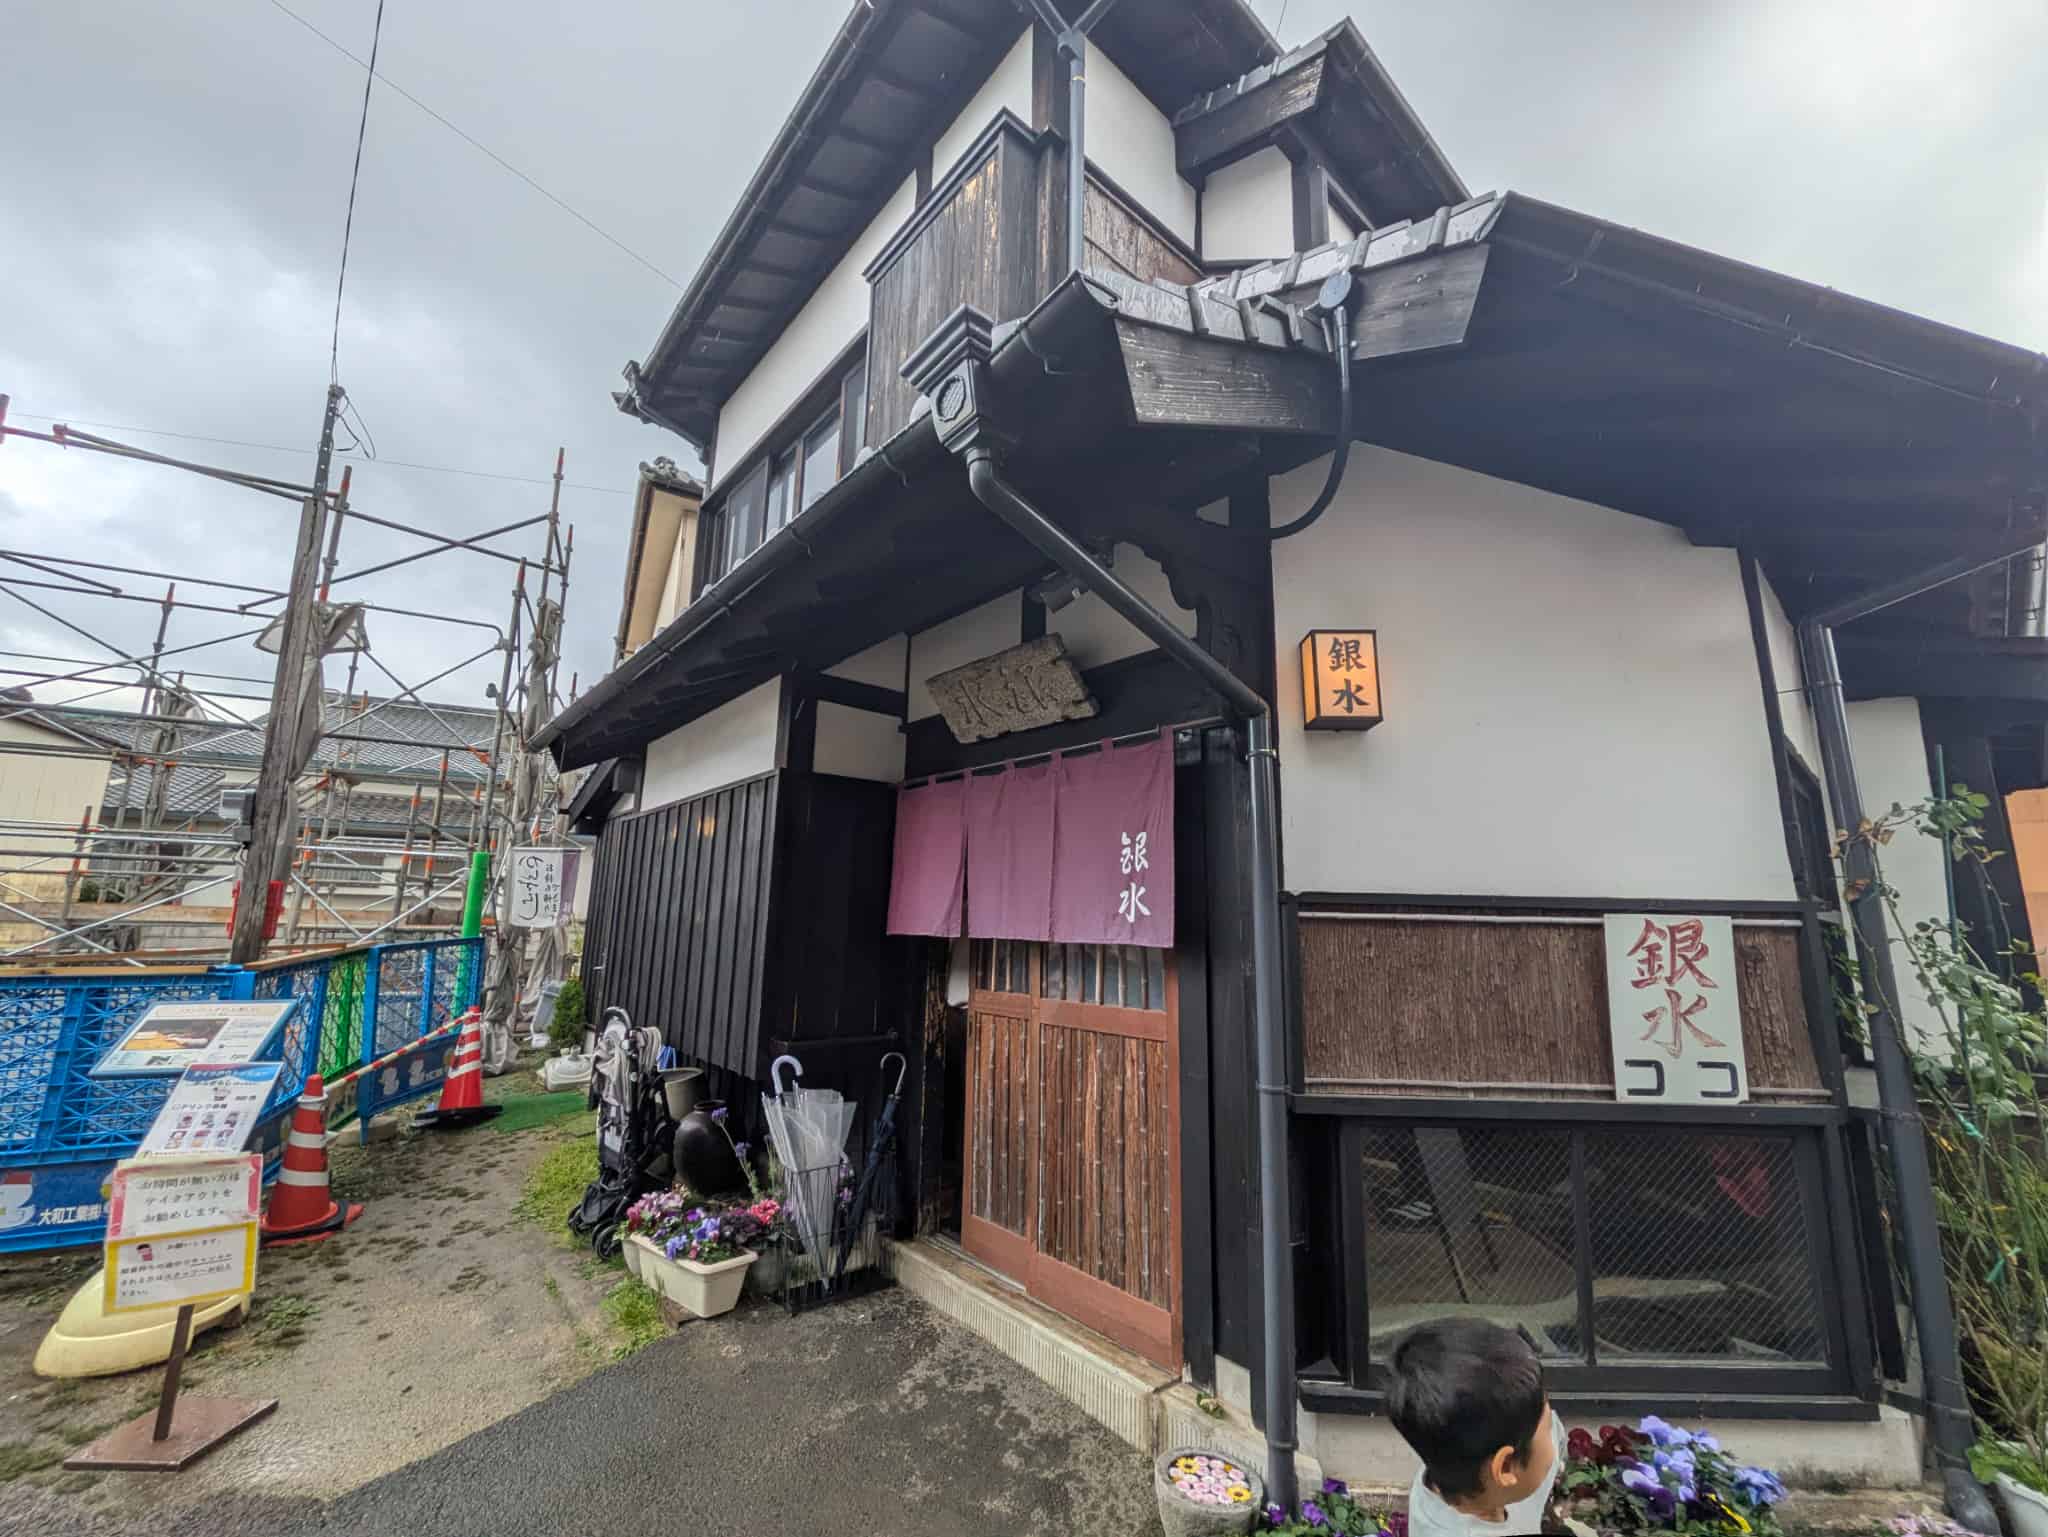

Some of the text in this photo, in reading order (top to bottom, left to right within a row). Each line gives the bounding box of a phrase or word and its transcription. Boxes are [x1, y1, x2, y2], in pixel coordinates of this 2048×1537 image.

[1328, 637, 1370, 714] 銀水
[1119, 831, 1151, 923] 銀水
[1627, 917, 1728, 1059] 銀水
[144, 1188, 232, 1205] テイクアウトを
